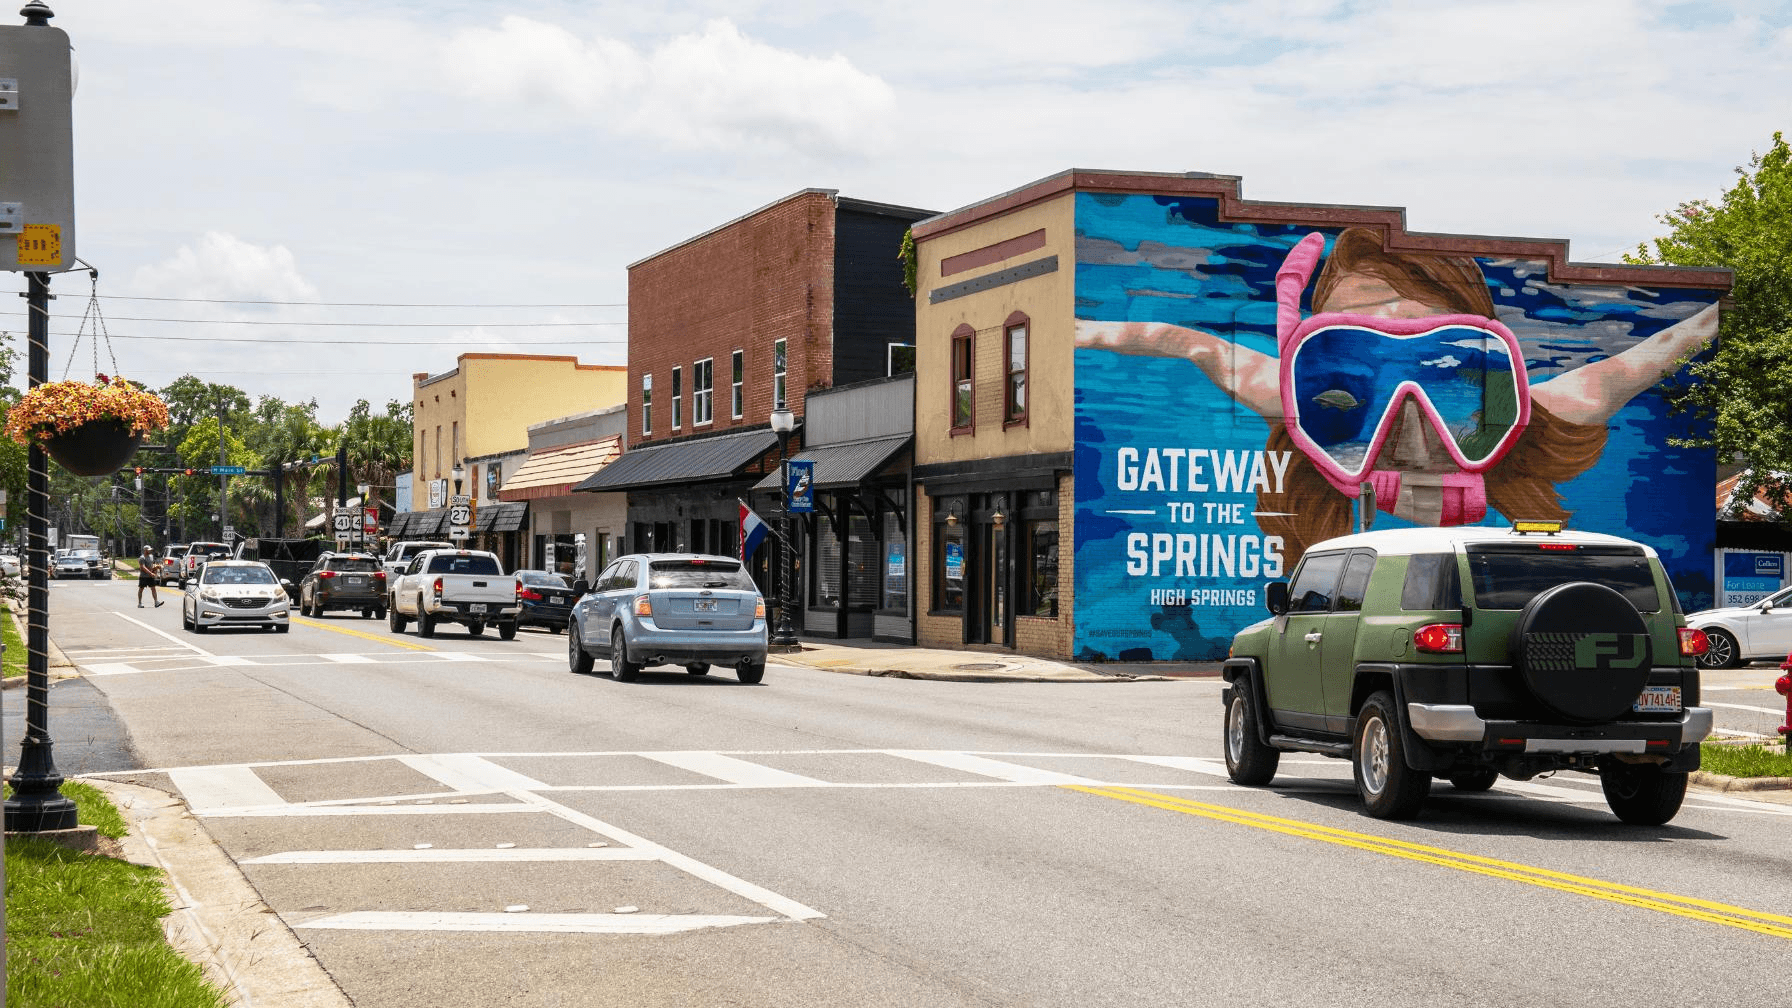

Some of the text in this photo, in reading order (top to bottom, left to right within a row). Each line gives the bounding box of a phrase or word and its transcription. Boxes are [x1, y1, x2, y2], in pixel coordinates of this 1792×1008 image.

[1117, 447, 1293, 494] GATEWAY
[338, 518, 348, 526] 41
[453, 510, 468, 520] 27
[1167, 502, 1245, 524] TO THE
[1126, 532, 1285, 578] SPRINGS
[1727, 580, 1765, 590] For Lease
[1150, 588, 1256, 607] HIGH SPRINGS
[1728, 595, 1742, 604] 352
[1575, 633, 1646, 668] FJ
